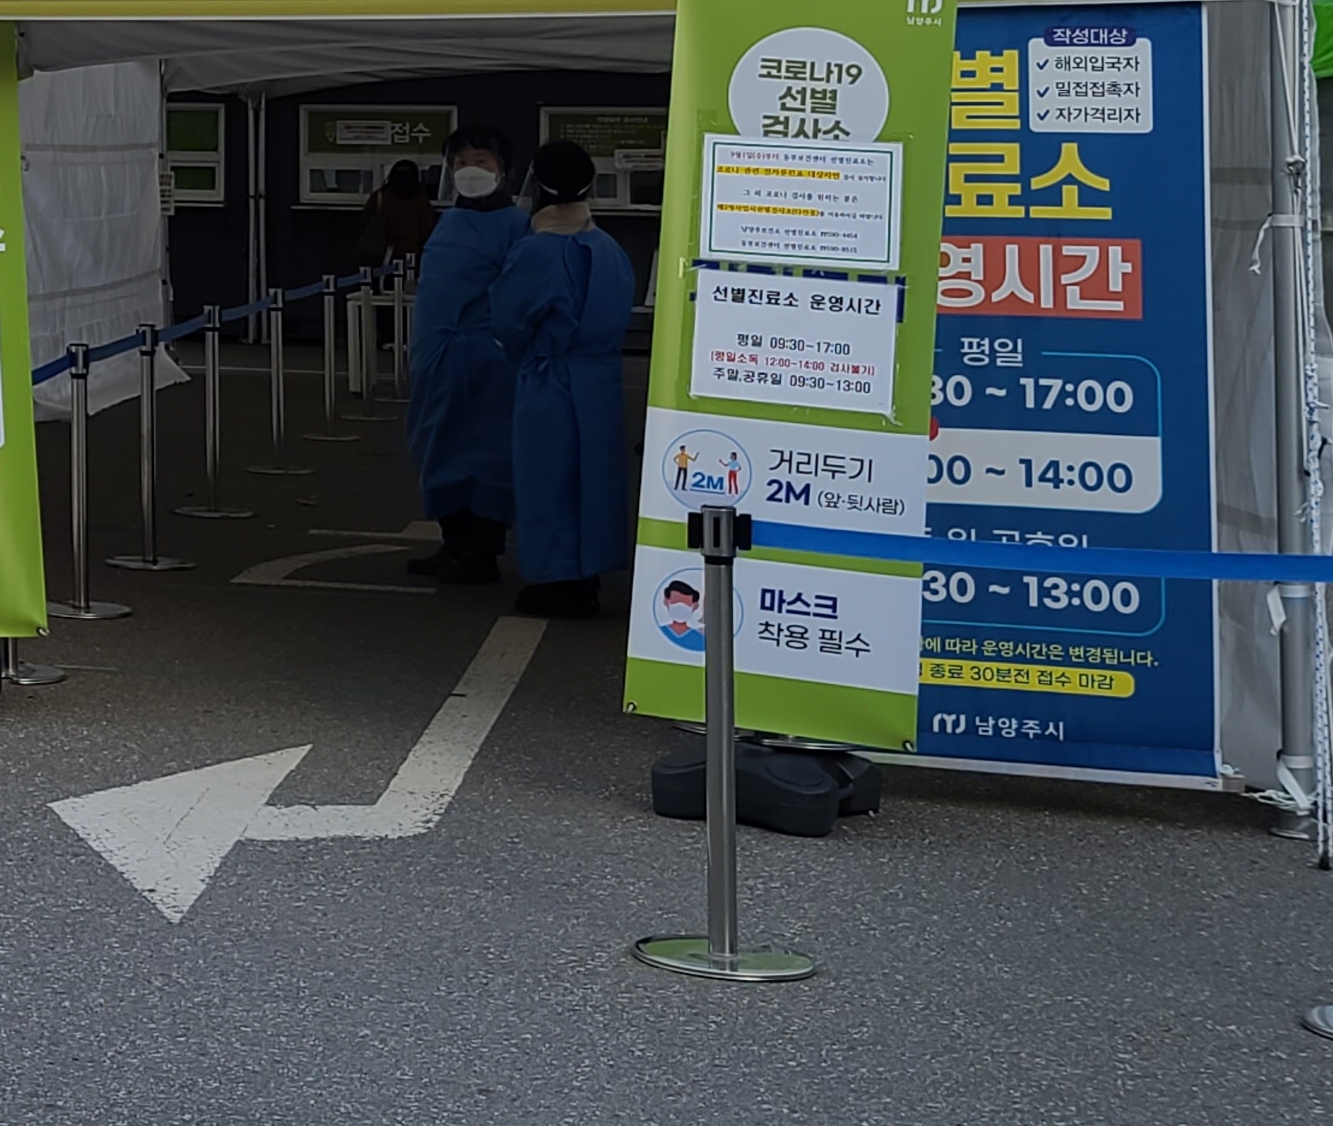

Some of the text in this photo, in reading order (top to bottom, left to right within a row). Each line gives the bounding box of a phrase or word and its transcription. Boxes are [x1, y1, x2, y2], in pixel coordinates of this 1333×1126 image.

[1052, 27, 1128, 45] 작성대상
[758, 57, 863, 85] 코로나19
[1054, 55, 1140, 73] 해외입국자
[778, 86, 838, 115] 선별
[950, 49, 1021, 129] 별
[1055, 81, 1141, 98] 밀접접촉자
[762, 114, 851, 141] 검사소
[1055, 106, 1141, 124] 자가격리자
[390, 122, 432, 144] 접수
[945, 142, 1113, 220] 료소
[937, 242, 1132, 312] 영시간
[712, 285, 882, 315] 선별진료소 운영시간
[737, 333, 851, 355] 평일 09:30~17:00
[960, 336, 1024, 367] 평일
[789, 374, 871, 394] 09:30~13:00
[929, 374, 1133, 413] 30 17:00
[769, 448, 874, 483] 거리두기
[927, 454, 1133, 494] 00 14:00
[691, 471, 724, 491] 2M
[766, 479, 811, 506] 2M
[760, 588, 839, 620] 마스크
[923, 569, 1140, 614] 30 13:00
[757, 621, 871, 658] 착용 필수
[945, 637, 978, 655] 따라
[981, 639, 1065, 661] 운영시간은
[1069, 645, 1160, 667] 변경됩니다.
[929, 662, 1115, 690] 종료 30분전 접수 마감
[975, 715, 1065, 741] 남양주시
